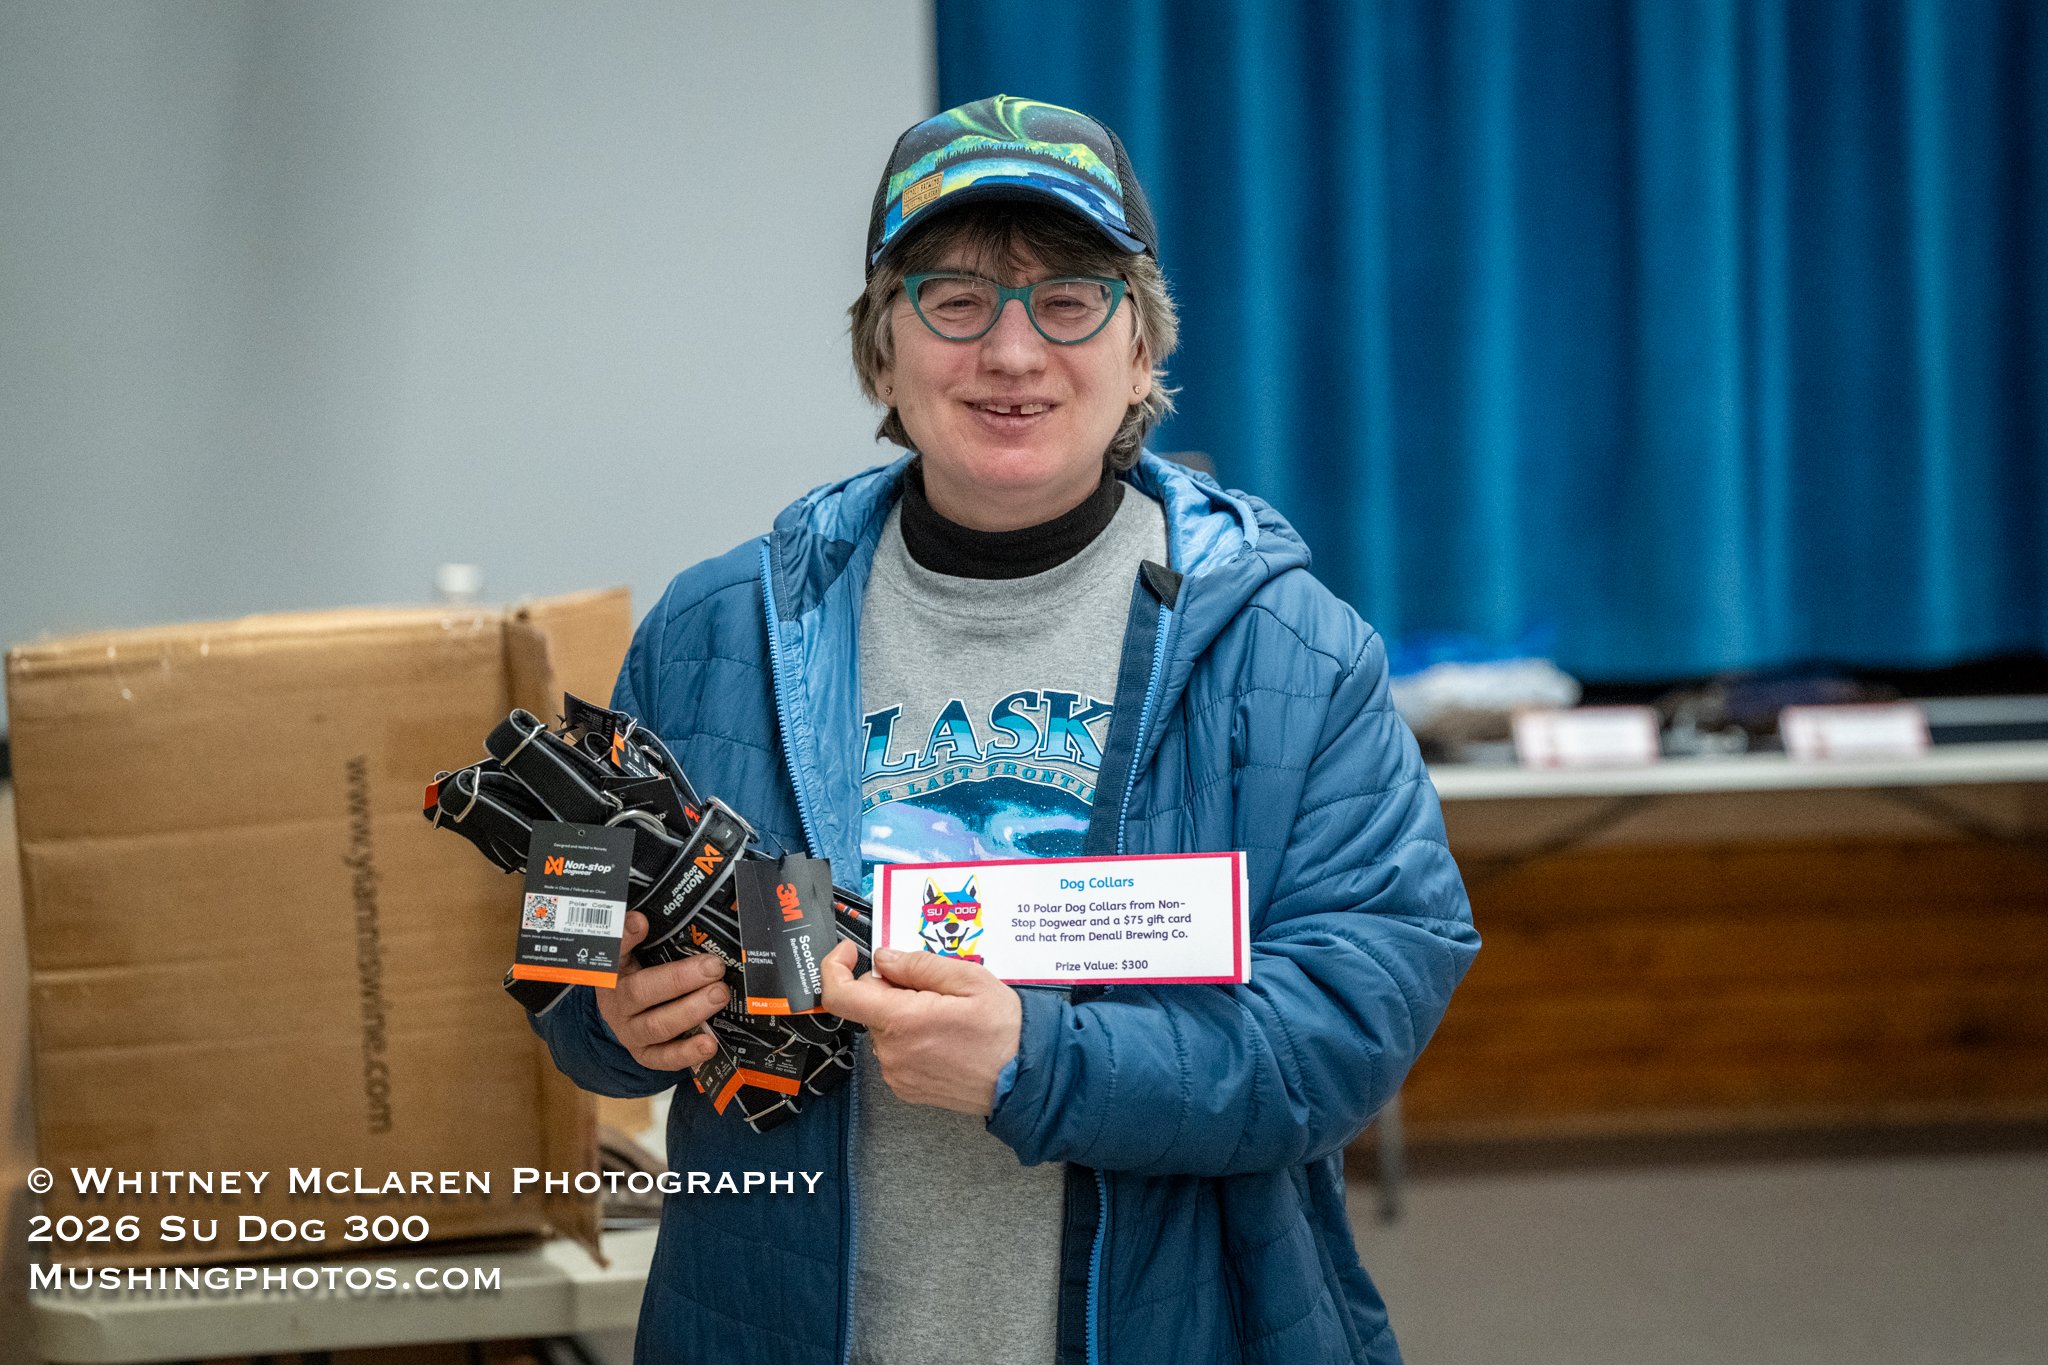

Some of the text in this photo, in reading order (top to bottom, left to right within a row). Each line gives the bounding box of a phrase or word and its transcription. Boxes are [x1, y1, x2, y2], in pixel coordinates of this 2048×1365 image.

[862, 688, 1114, 783] LASK
[862, 789, 893, 812] HE
[908, 766, 973, 795] LAST
[563, 868, 592, 876] dogwear
[1060, 877, 1134, 891] Dog Collars
[662, 870, 705, 916] Non-stop
[776, 882, 803, 922] 3M
[1017, 900, 1186, 914] 10 Polar Dog Collars from Non-
[927, 906, 977, 917] SU DOG
[1011, 918, 1036, 929] Stop
[1039, 918, 1087, 930] Dogwear
[1090, 916, 1110, 926] and
[1124, 915, 1144, 925] $75
[1147, 914, 1165, 927] gift
[1168, 914, 1191, 924] card
[1015, 929, 1188, 942] and hat from Denali Brewing Co.
[704, 940, 745, 973] Non-sto
[747, 950, 770, 958] UNLEASH
[747, 957, 773, 965] POTENTIAL
[790, 938, 811, 995] Reflective Material
[799, 934, 822, 995] Scotchlite
[1055, 960, 1149, 971] Prize Value: $300
